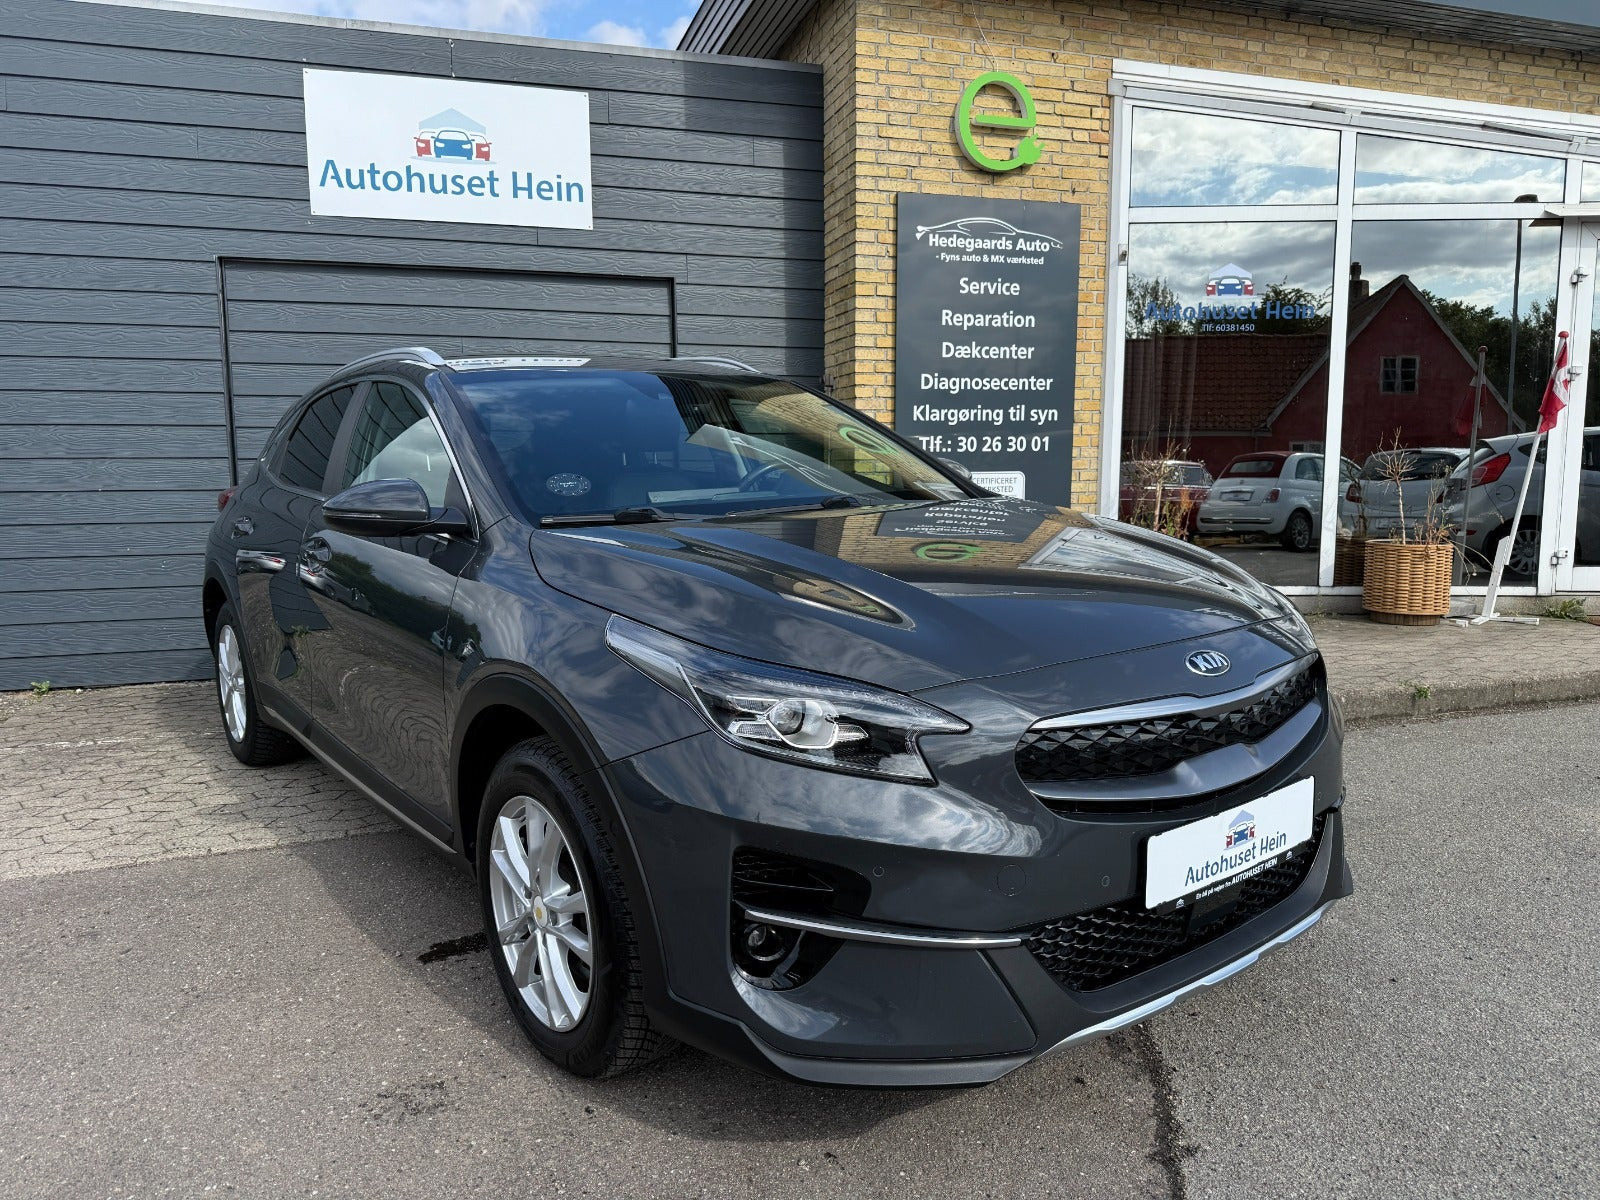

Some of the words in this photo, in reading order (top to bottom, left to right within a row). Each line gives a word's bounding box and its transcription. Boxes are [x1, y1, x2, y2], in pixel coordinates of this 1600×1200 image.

[319, 159, 500, 198] Autohuset
[512, 171, 584, 203] Hein
[928, 233, 1013, 252] Hedegaards
[1015, 238, 1050, 252] Auto
[940, 252, 960, 262] Fyns
[961, 254, 982, 263] auto
[982, 255, 989, 263] &
[990, 254, 1005, 264] MX
[1006, 256, 1044, 265] værksted
[959, 277, 1021, 296] Service
[941, 309, 1036, 331] Reparation
[1145, 300, 1258, 321] Autohuset
[1265, 301, 1315, 320] Hein
[1215, 323, 1255, 332] 60381450
[941, 341, 1035, 360] Dækcenter
[920, 373, 1054, 395] Diagnosecenter
[912, 404, 1004, 426] Klargøring
[1008, 404, 1026, 422] til
[1029, 408, 1059, 426] syn
[919, 435, 952, 453] Tlf.:
[957, 436, 978, 453] 30
[982, 436, 1002, 453] 26
[1006, 435, 1027, 452] 30
[1031, 435, 1050, 452] 01
[1190, 652, 1228, 671] KIA
[1185, 843, 1256, 887] Autohuset
[1260, 831, 1287, 856] Hein
[1231, 863, 1264, 885] AUTOHUSET
[1264, 857, 1278, 870] HEIN
